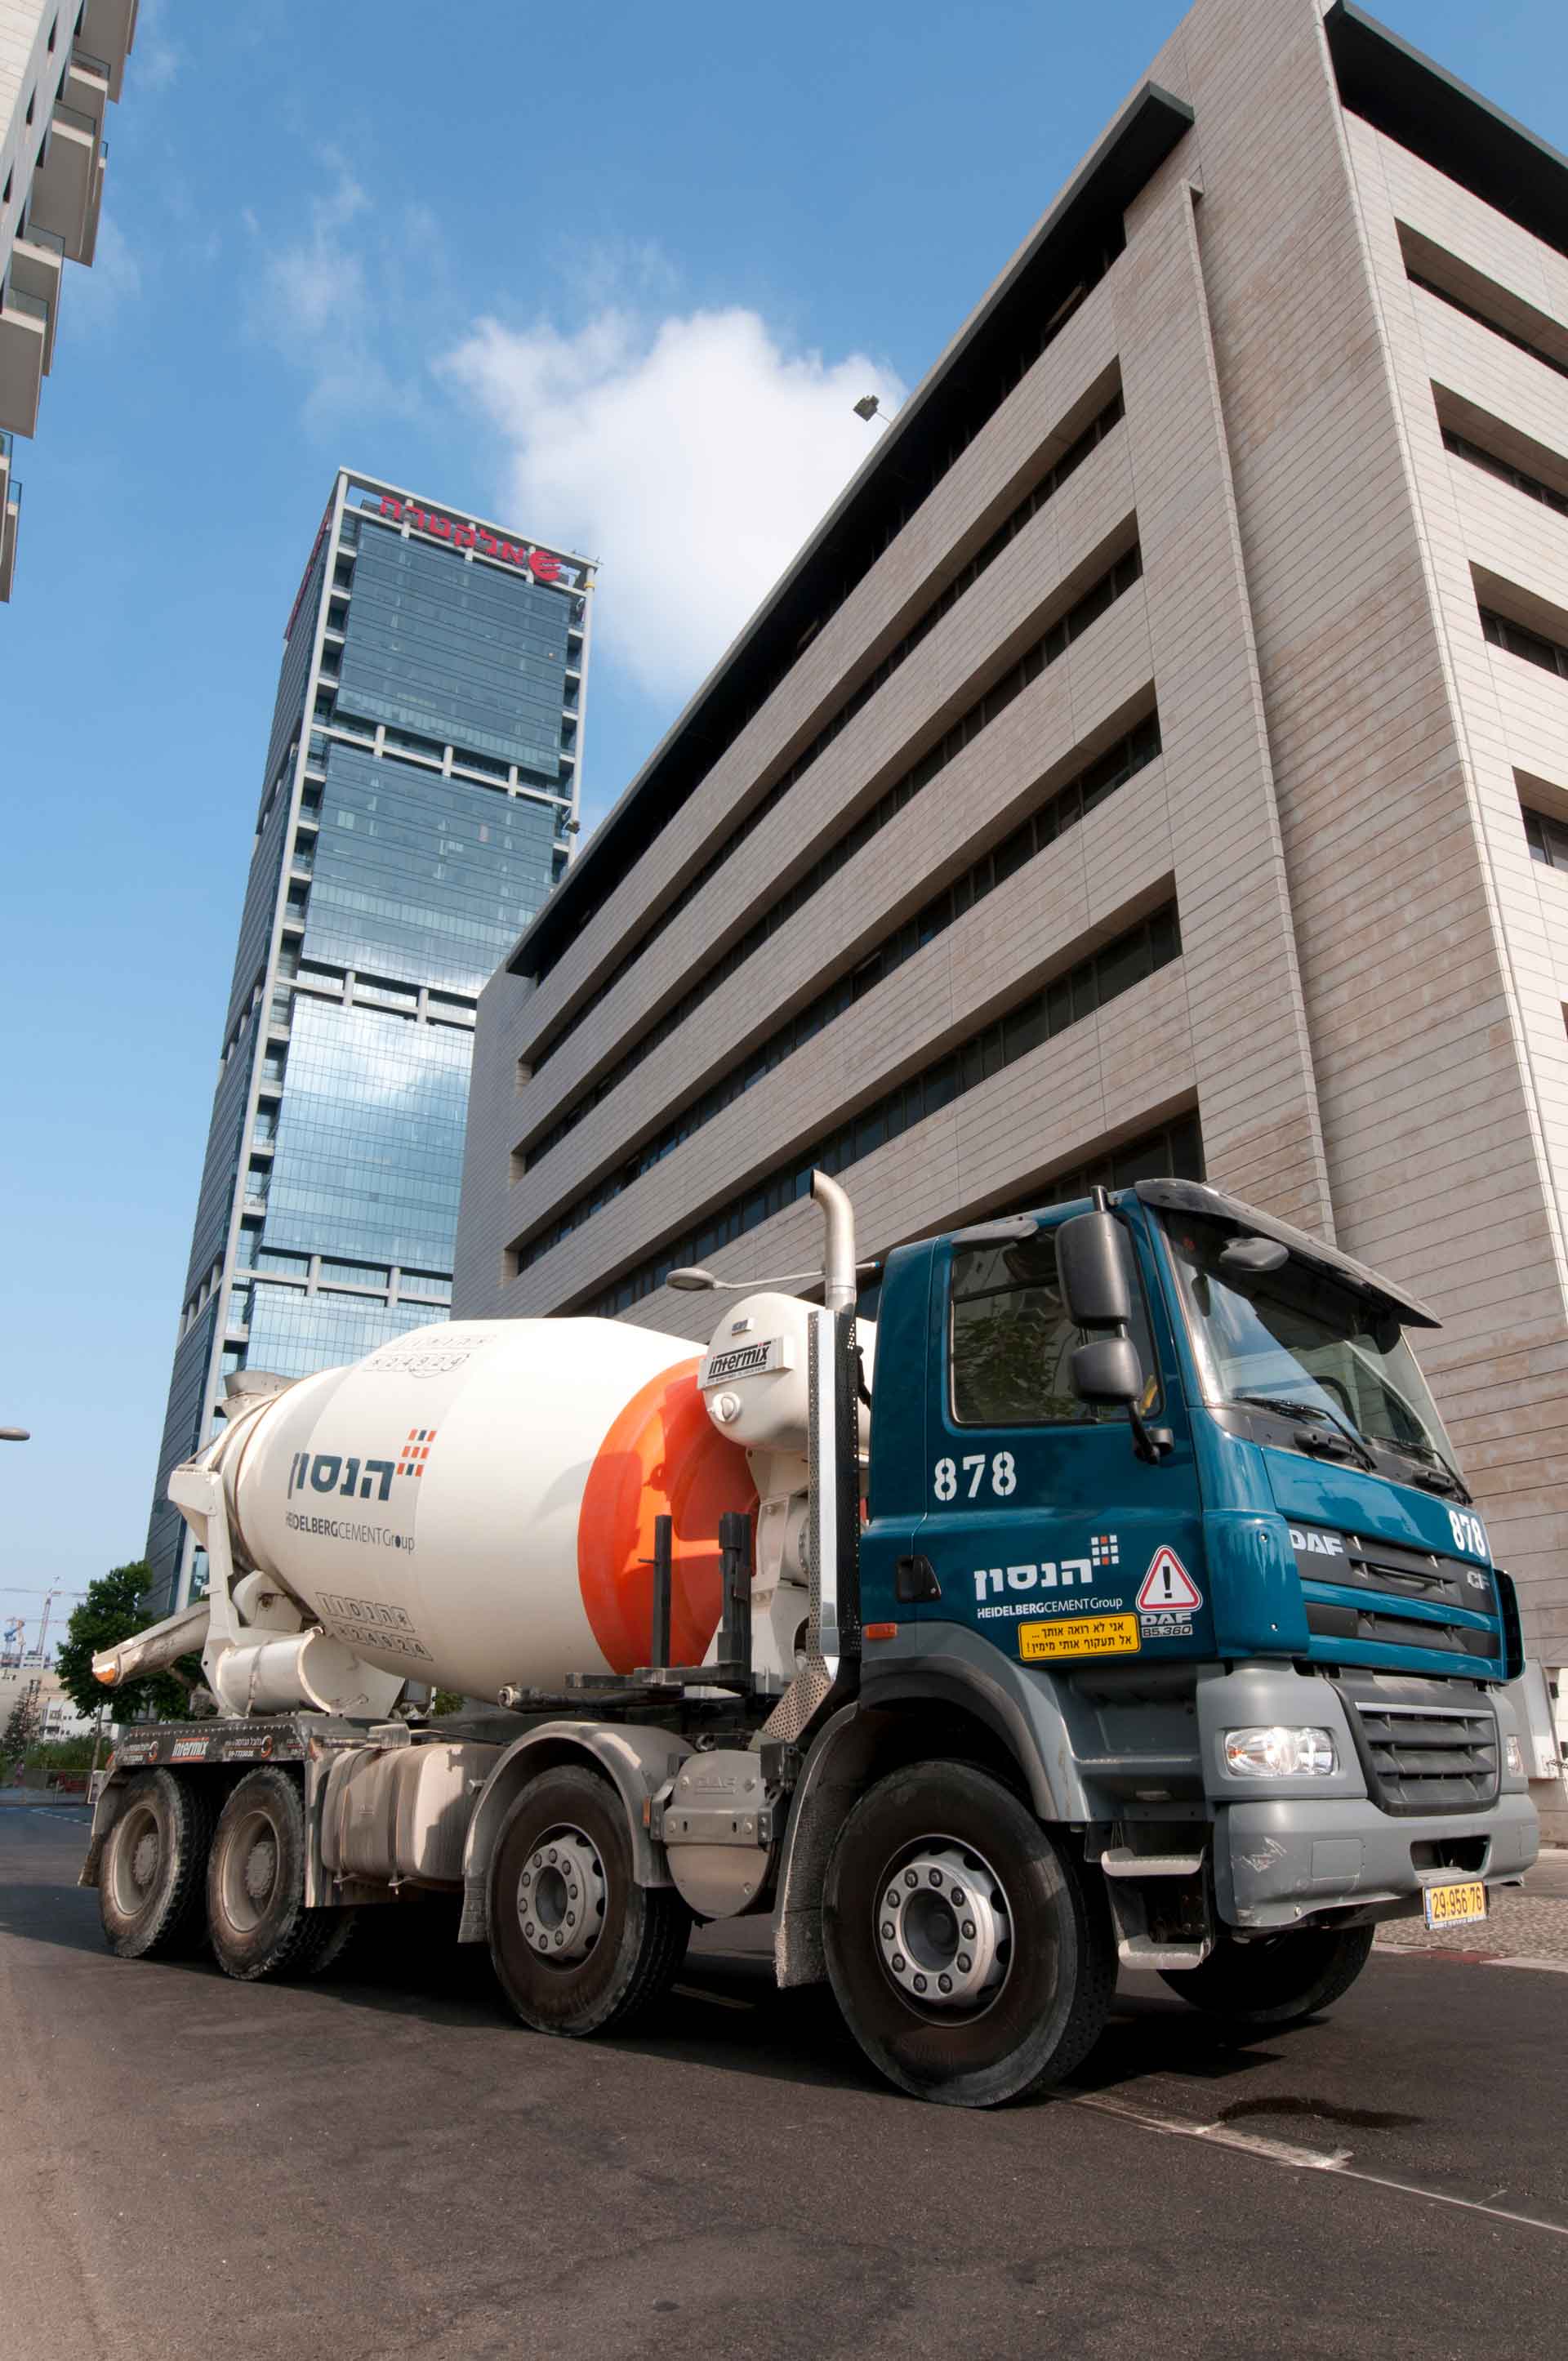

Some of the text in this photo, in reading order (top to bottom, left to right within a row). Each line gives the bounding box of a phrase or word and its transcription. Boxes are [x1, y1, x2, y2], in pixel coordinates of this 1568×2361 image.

[380, 496, 524, 565] אלקטרה
[709, 1342, 769, 1375] intermix
[287, 1453, 395, 1501] הנסון
[934, 1451, 1017, 1501] 878
[1449, 1510, 1487, 1557] 878
[1289, 1530, 1344, 1556] DAF
[974, 1559, 1093, 1601] הנסון
[1113, 1622, 1124, 1631] אני
[1141, 1612, 1192, 1626] DAF
[1067, 1624, 1089, 1636] רואה
[1094, 1622, 1105, 1633] לא
[1143, 1625, 1192, 1637] 85.360
[1059, 1639, 1080, 1649] אותי
[1084, 1637, 1115, 1650] תעקוף
[1119, 1635, 1132, 1645] אל
[172, 1738, 210, 1757] intermix
